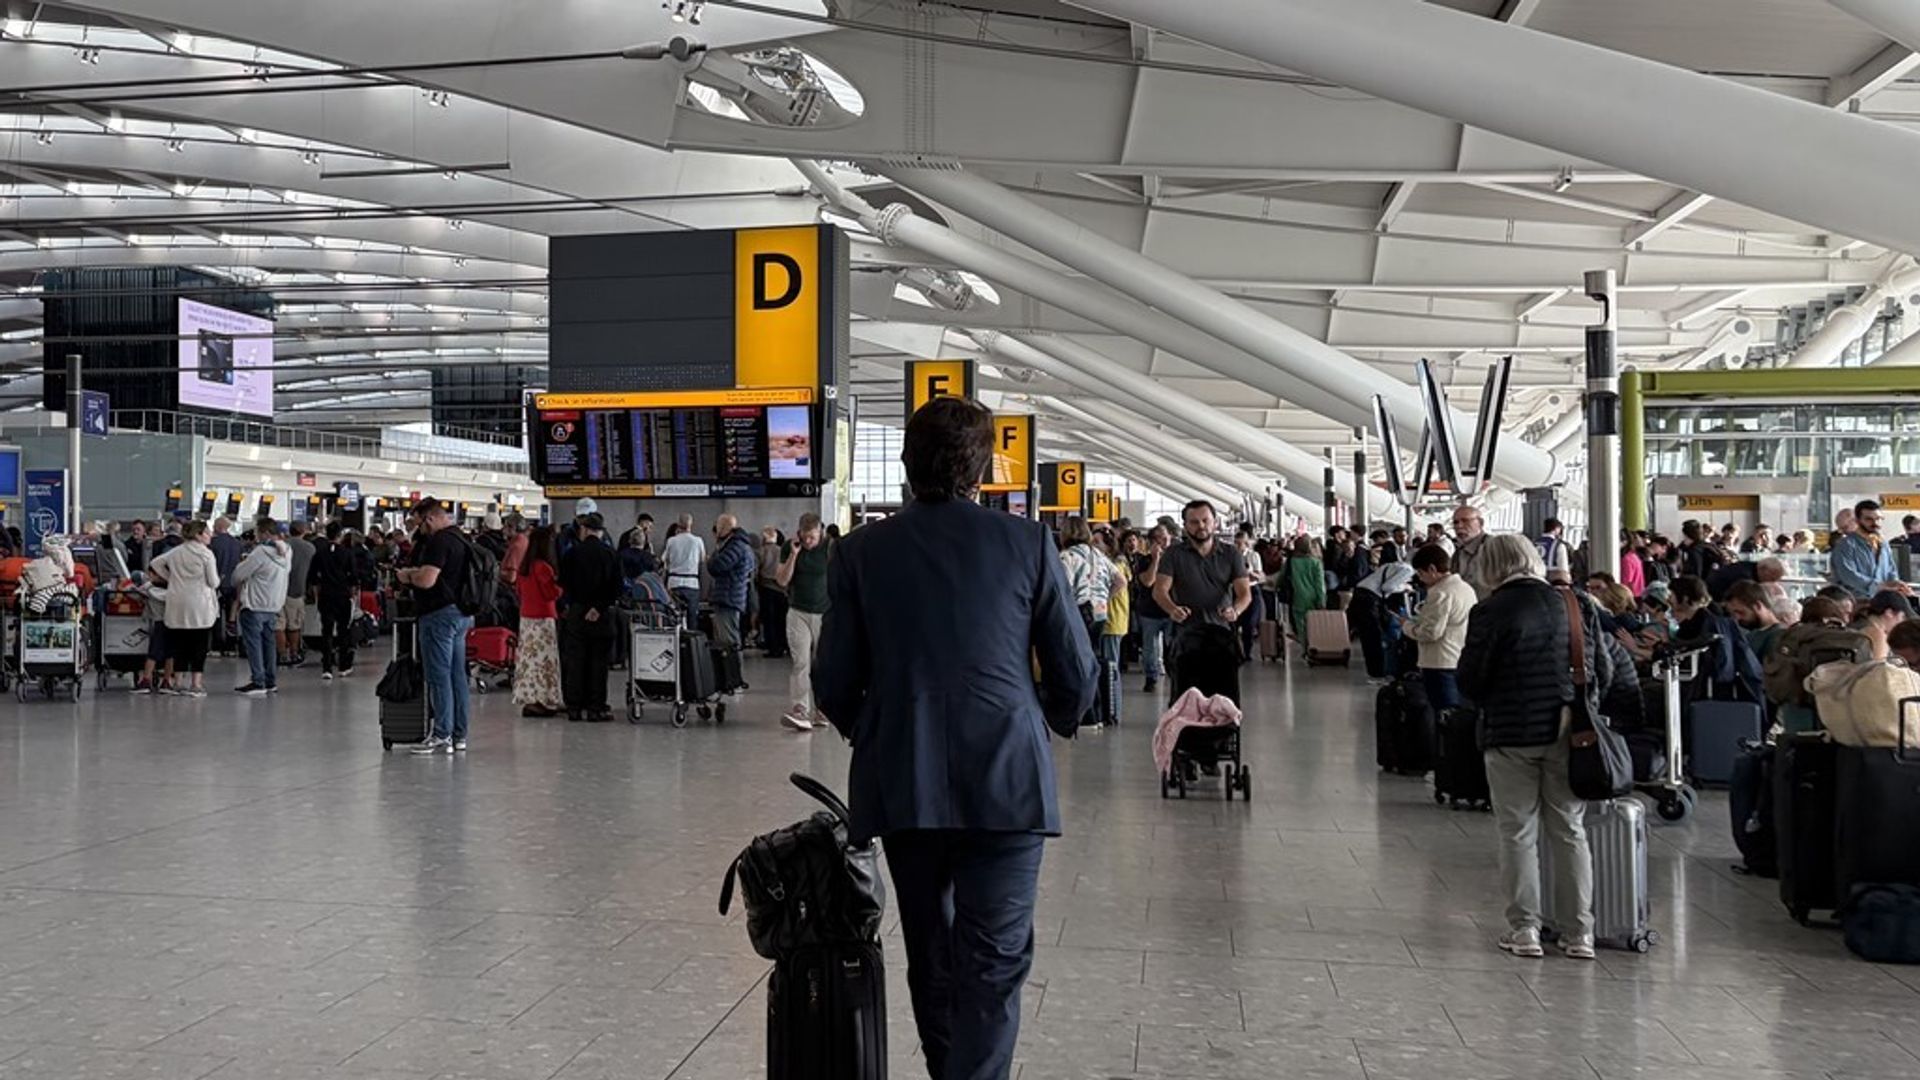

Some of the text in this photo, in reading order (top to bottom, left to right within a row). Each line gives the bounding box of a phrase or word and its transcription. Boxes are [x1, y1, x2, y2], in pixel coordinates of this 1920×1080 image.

[753, 253, 802, 310] D
[928, 376, 949, 397] E
[1003, 427, 1017, 449] F
[1061, 469, 1076, 485] G
[1097, 494, 1107, 503] H
[1689, 497, 1713, 506] Lifts
[1887, 497, 1909, 506] Lifts
